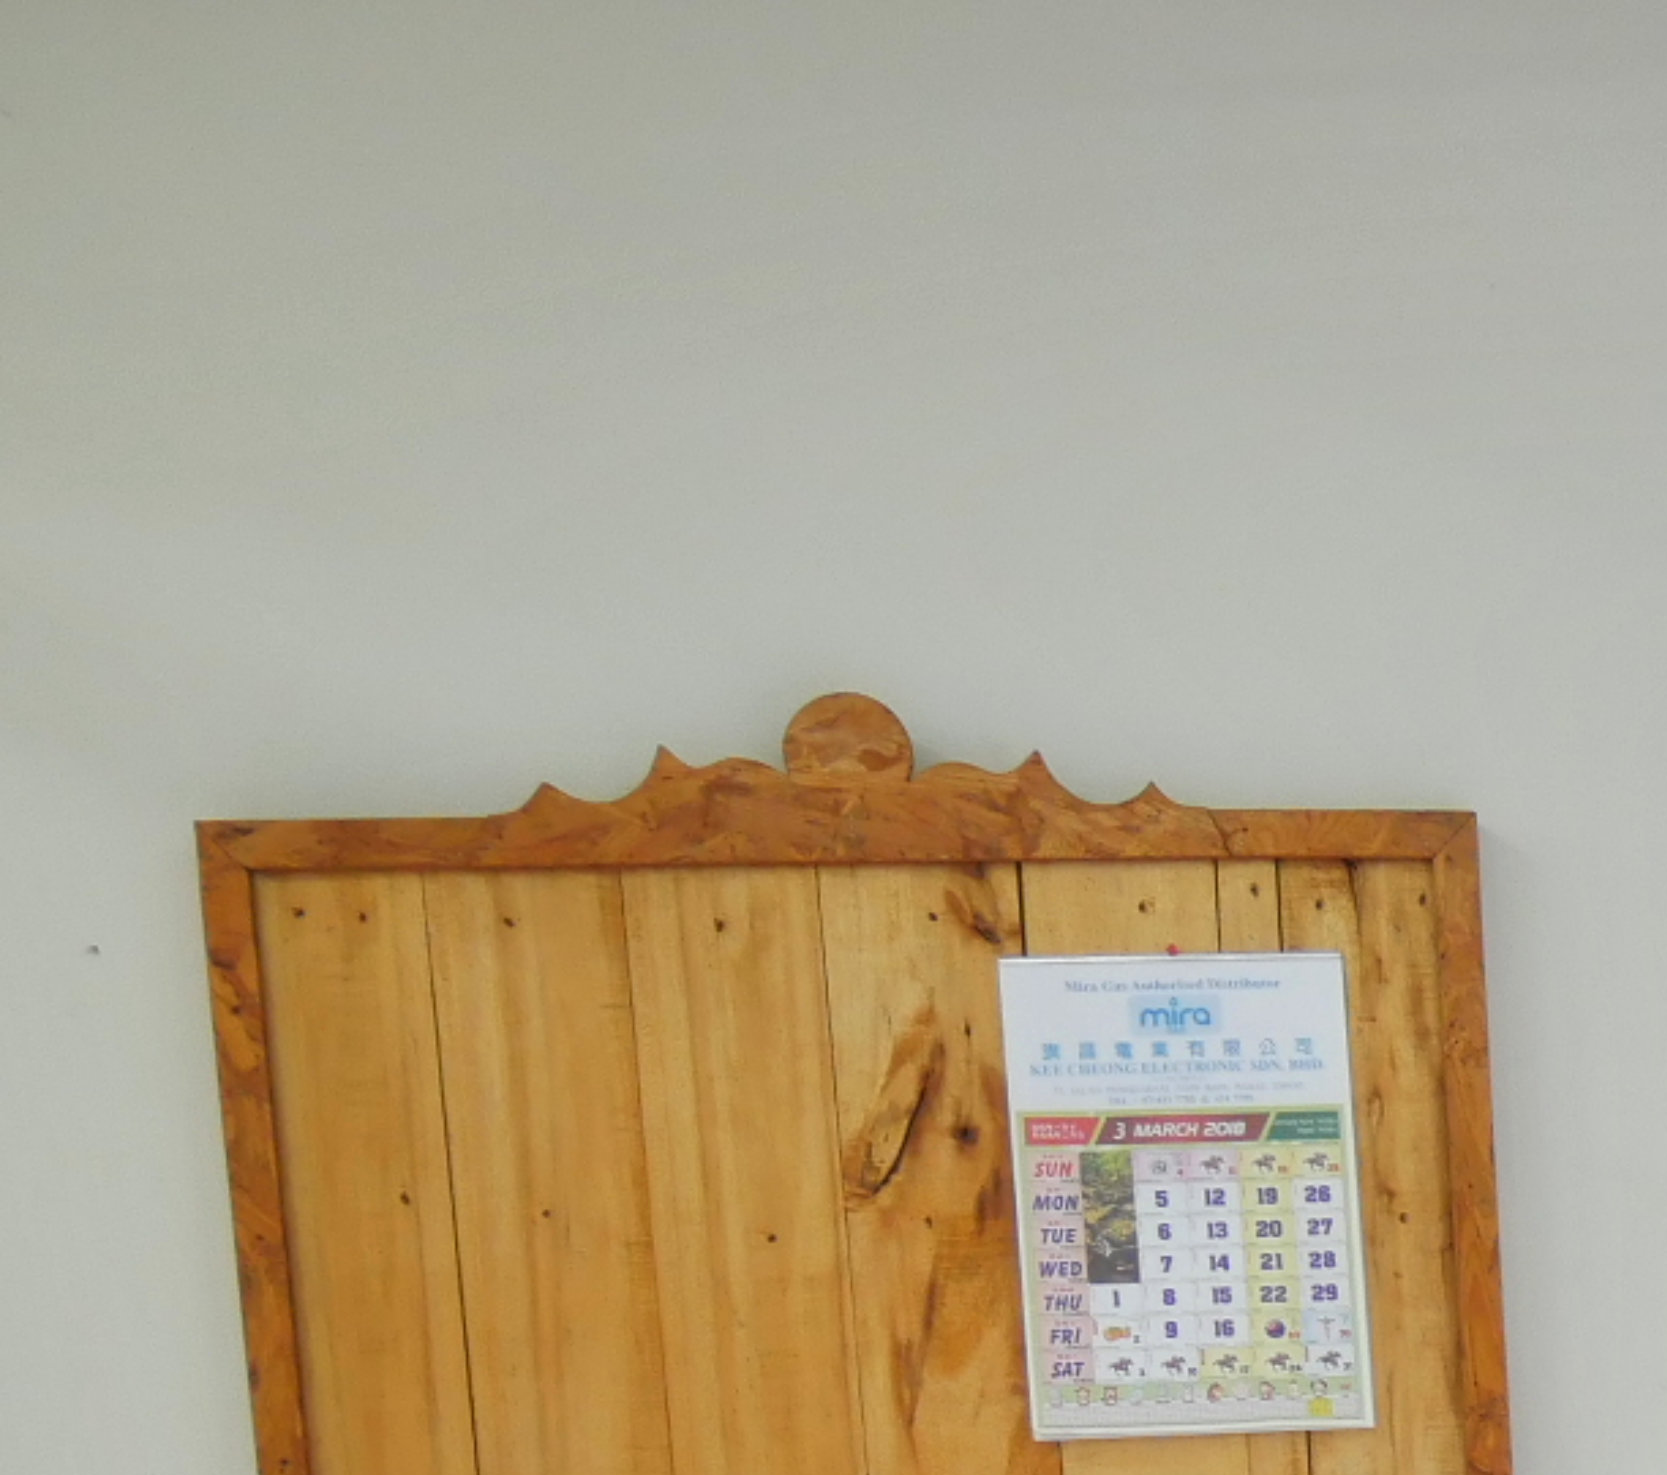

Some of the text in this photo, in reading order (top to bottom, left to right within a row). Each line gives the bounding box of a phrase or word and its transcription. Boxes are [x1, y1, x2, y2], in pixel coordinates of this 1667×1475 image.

[1139, 996, 1211, 1027] mira
[1113, 1122, 1126, 1141] 3
[1133, 1120, 1199, 1138] MARCH
[1034, 1162, 1073, 1178] SUN
[1032, 1185, 1331, 1211] MON 5 12 19 26
[1041, 1218, 1333, 1244] TUE 6 13 20 27
[1039, 1250, 1336, 1278] WED 7 14 21 28
[1044, 1283, 1338, 1311] THU 1 8 15 22 29
[1050, 1328, 1081, 1345] FRI
[1165, 1321, 1178, 1338] 9
[1214, 1318, 1235, 1338] 16
[1051, 1361, 1085, 1378] SAT
